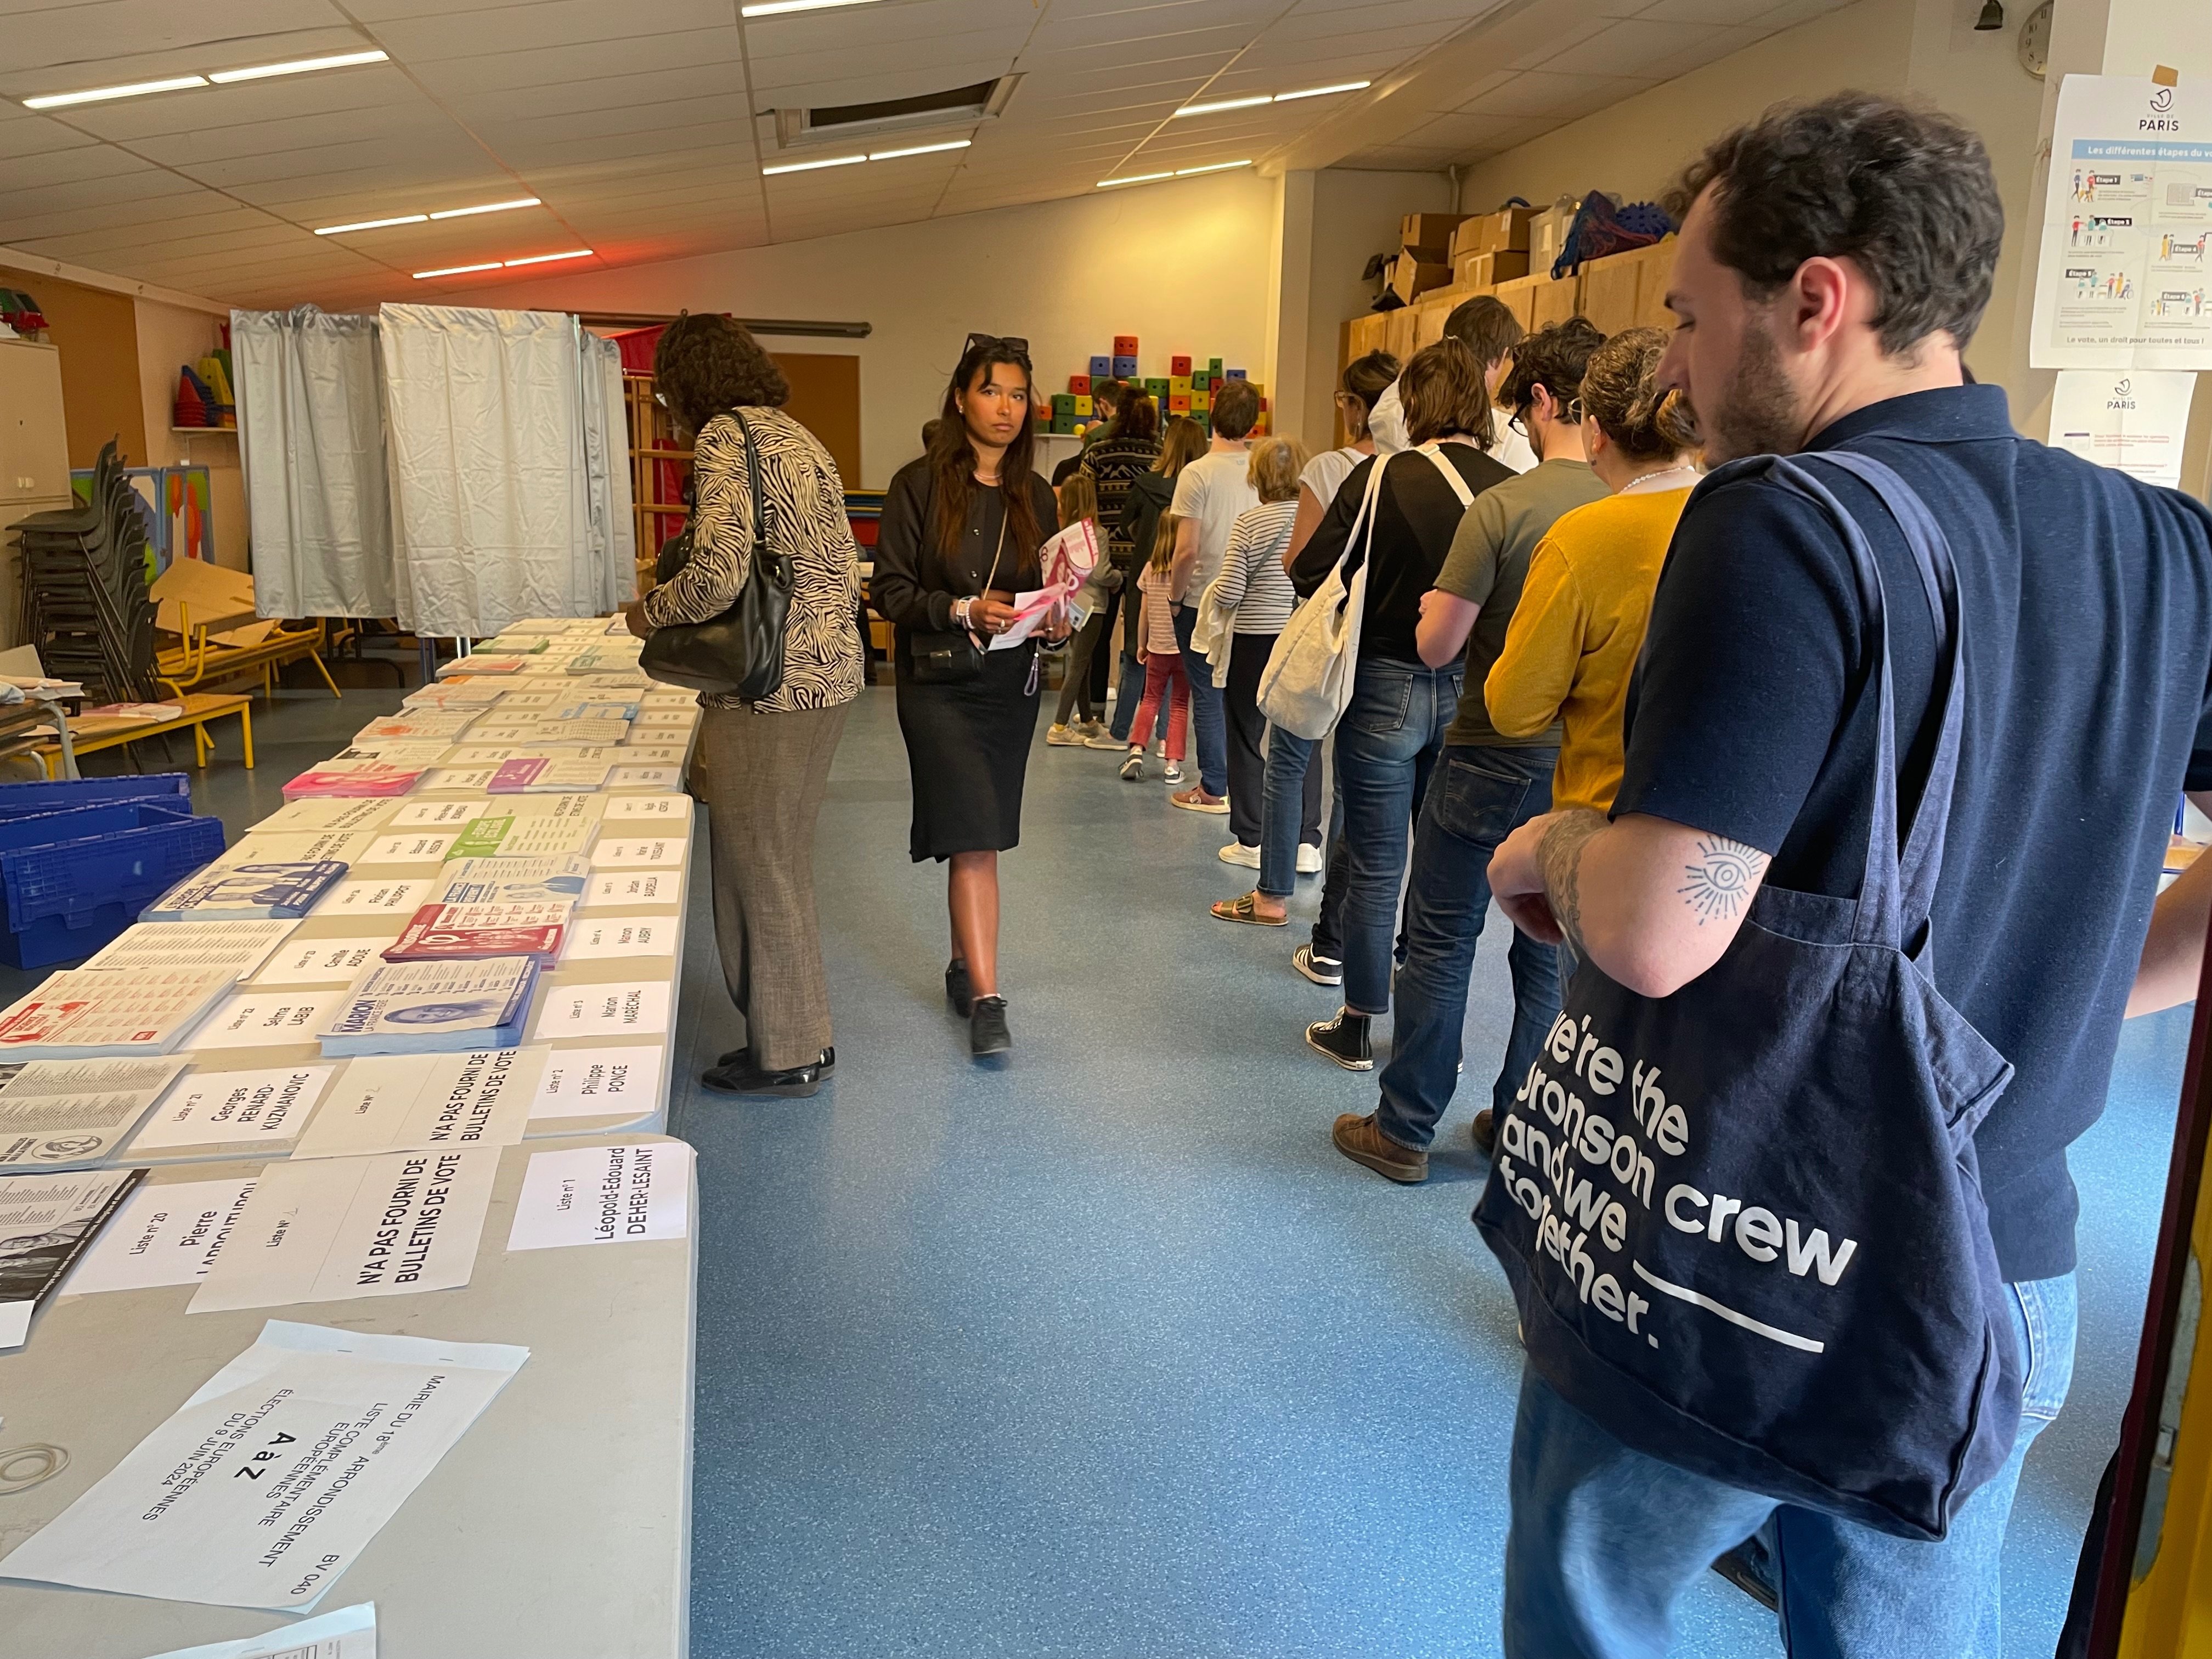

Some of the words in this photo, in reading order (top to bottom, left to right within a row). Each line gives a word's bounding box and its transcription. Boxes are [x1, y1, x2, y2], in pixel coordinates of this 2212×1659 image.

[2139, 120, 2179, 131] PARIS
[2088, 146, 2103, 155] Les
[2106, 145, 2156, 156] différentes
[2158, 146, 2188, 159] étapes
[2190, 148, 2202, 157] du
[2107, 401, 2135, 409] PARIS
[369, 889, 390, 903] Florian
[384, 885, 410, 906] PHILIPPOT
[627, 881, 639, 893] Jordan
[644, 877, 657, 896] BARDELLA
[618, 928, 632, 944] Manon
[638, 928, 651, 943] AUBRY
[324, 950, 349, 967] Camille
[347, 949, 371, 967] ADOUE
[263, 1008, 291, 1026] Selma
[287, 1007, 314, 1025] LABIB
[342, 999, 379, 1032] MARION
[570, 1009, 581, 1018] Liste
[601, 997, 618, 1017] Marion
[622, 990, 641, 1023] MARÉCHAL
[468, 1054, 488, 1065] DE
[491, 1051, 516, 1073] VOTE
[449, 1068, 482, 1100] FOURNI
[485, 1075, 506, 1086] DE
[547, 1081, 560, 1093] Liste
[582, 1065, 605, 1094] Philippe
[608, 1065, 628, 1092] PONGE
[211, 1088, 248, 1121] Georges
[237, 1084, 274, 1122] RENARD-
[260, 1074, 309, 1130] KUZMANOVIC
[355, 1102, 371, 1114] Liste
[439, 1103, 464, 1121] PAS
[1633, 1059, 1689, 1156] the
[172, 1108, 192, 1121] Liste
[460, 1089, 499, 1141] BULLETINS
[430, 1124, 455, 1141] N'A
[402, 1159, 427, 1175] DE
[431, 1155, 461, 1186] VOTE
[627, 1149, 652, 1234] DEHER-LESAINT
[1502, 1113, 1569, 1198] and
[1564, 1167, 1627, 1252] we
[381, 1178, 420, 1225] FOURNI
[424, 1188, 449, 1205] DE
[557, 1194, 572, 1210] Liste
[595, 1148, 625, 1239] Léopold-Edouard
[129, 1235, 154, 1254] Liste
[151, 1213, 167, 1222] 20
[179, 1211, 217, 1246] Pierre
[266, 1230, 286, 1247] Liste
[1665, 1183, 1858, 1285] crew
[369, 1229, 399, 1256] PAS
[394, 1209, 441, 1283] BULLETINS
[357, 1260, 388, 1284] N'A
[405, 1375, 445, 1410] MAIRIE
[224, 1413, 246, 1427] DU
[229, 1389, 294, 1440] ÉLECTIONS
[354, 1402, 388, 1429] LISTE
[390, 1413, 413, 1427] DU
[268, 1431, 296, 1444] A
[372, 1431, 394, 1454] 18ème
[188, 1437, 218, 1460] JUIN
[251, 1451, 283, 1461] à
[266, 1422, 349, 1499] EUROPÉENNES
[142, 1442, 235, 1520] EUROPÉENNES
[161, 1463, 193, 1485] 2024
[258, 1430, 360, 1527] COMPLÉMENTAIRE
[259, 1456, 369, 1567] ARRONDISSEMENT
[316, 1554, 340, 1571] BV
[291, 1573, 320, 1594] 040
